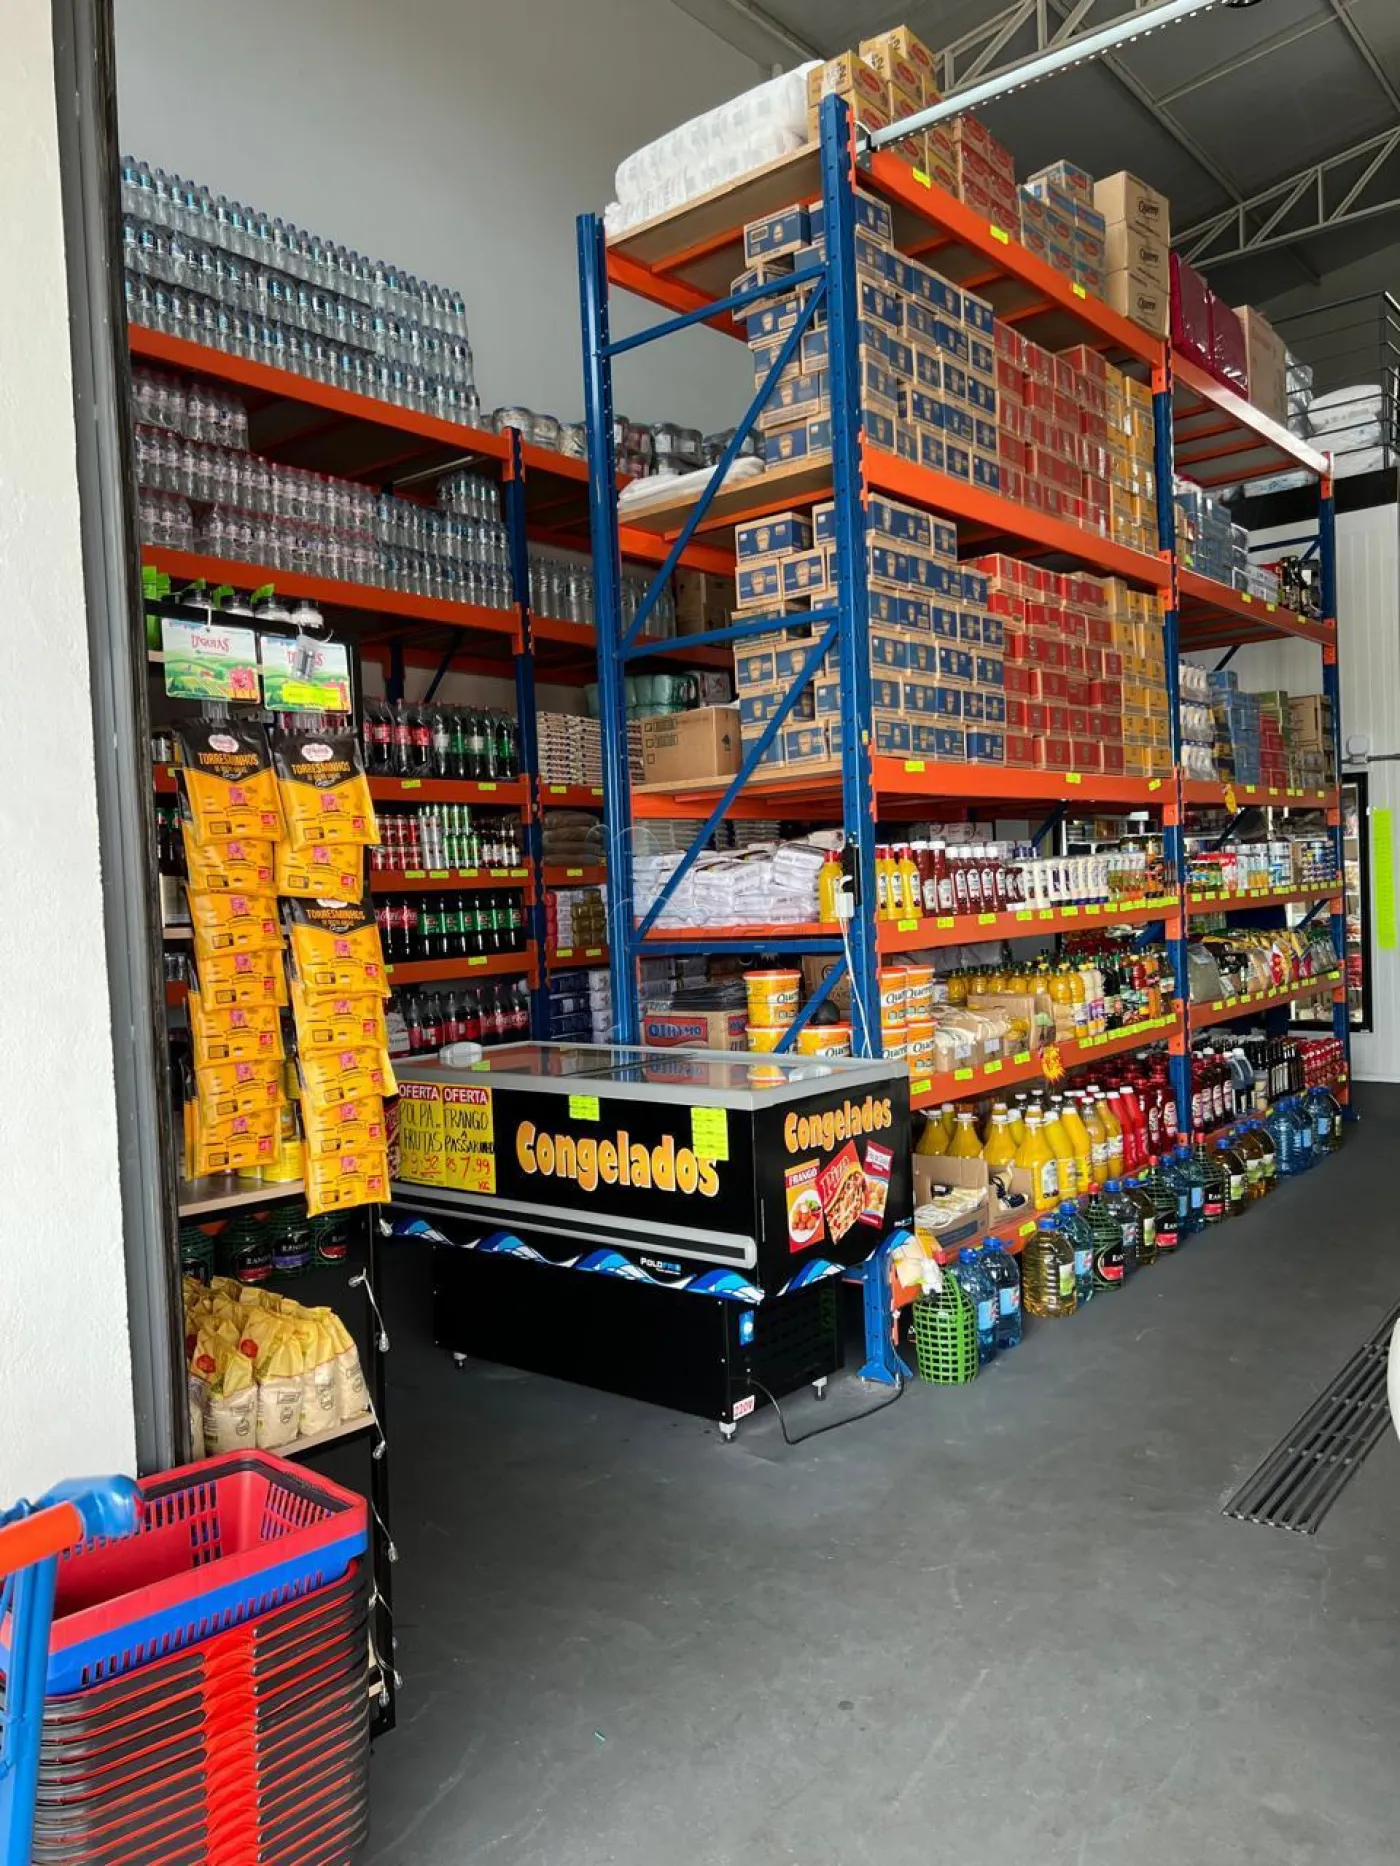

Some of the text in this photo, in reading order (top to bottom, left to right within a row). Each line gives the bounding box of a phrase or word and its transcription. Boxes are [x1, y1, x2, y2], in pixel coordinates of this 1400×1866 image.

[399, 1084, 439, 1100] OFERTA
[444, 1088, 488, 1104] OFERTA
[444, 1107, 489, 1131] FRANGO
[784, 1096, 892, 1153] Congelados
[403, 1127, 443, 1154] FRUTAS
[516, 1120, 719, 1197] Congelados
[790, 1167, 818, 1186] FRANGO
